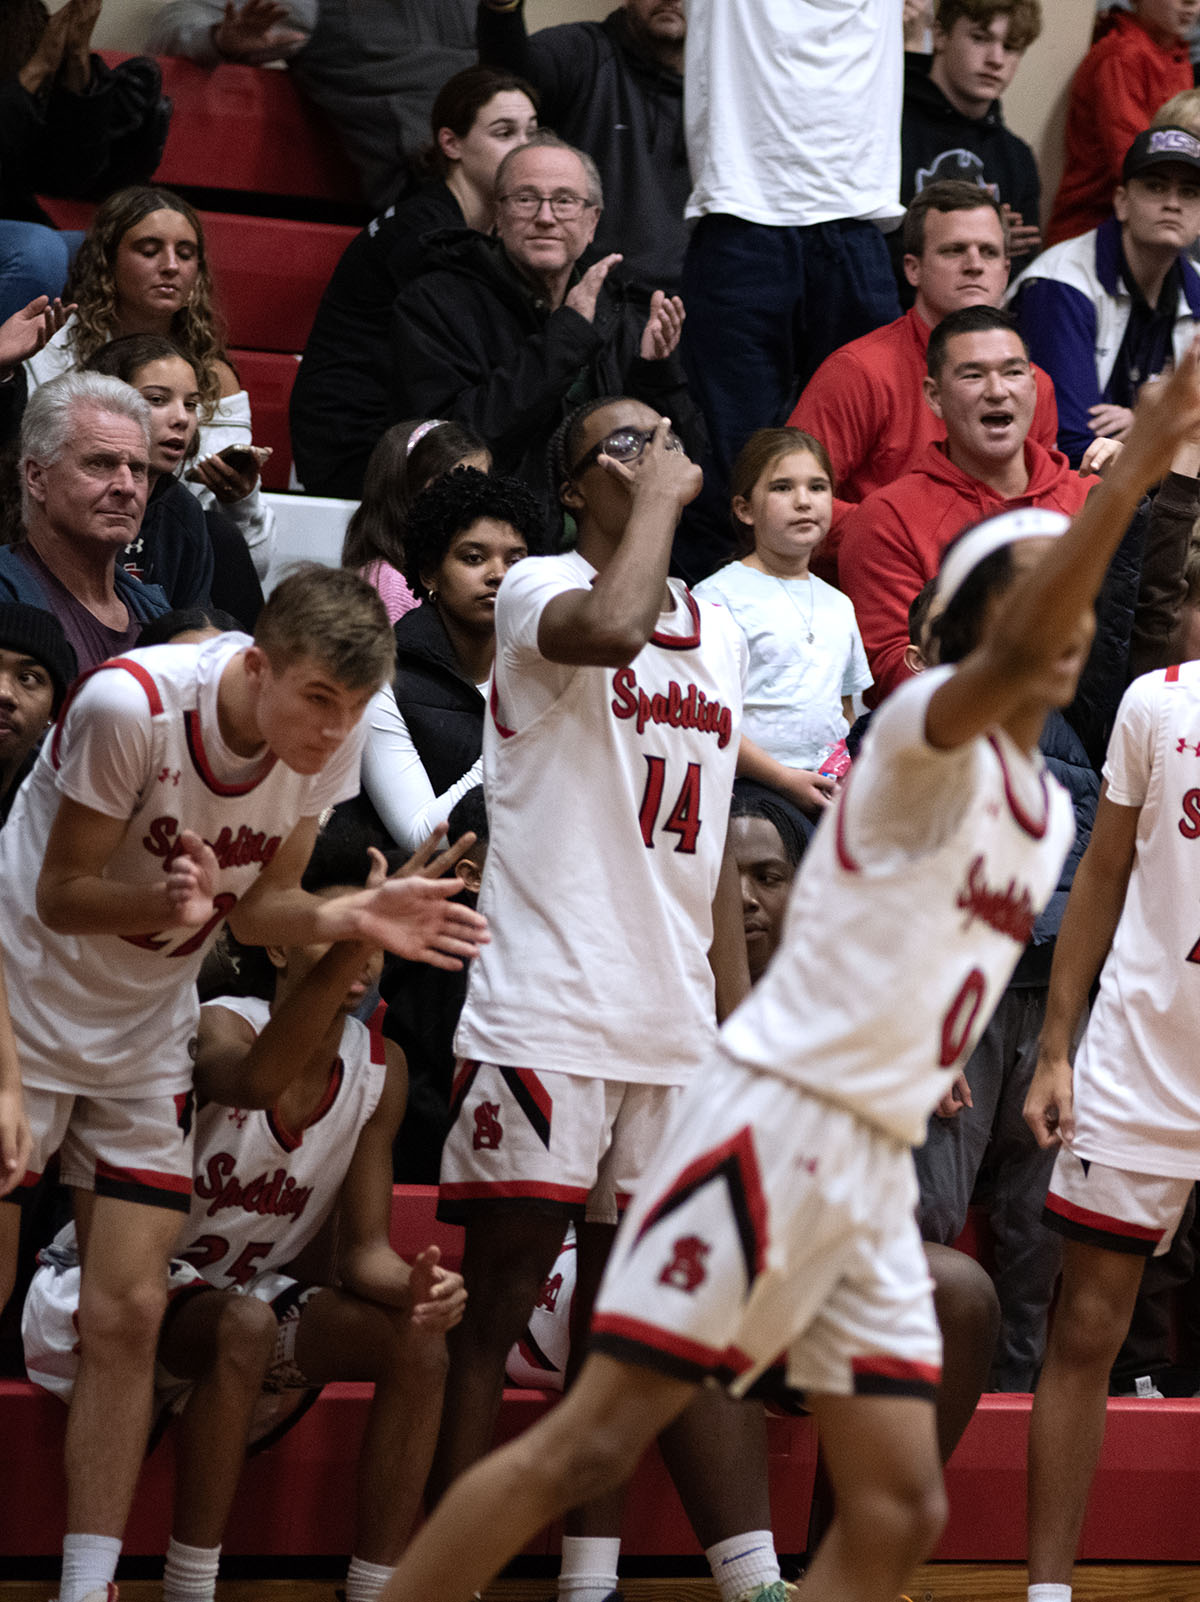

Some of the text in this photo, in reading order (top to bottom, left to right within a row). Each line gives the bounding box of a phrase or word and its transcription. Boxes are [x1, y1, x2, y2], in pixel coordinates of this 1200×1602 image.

[612, 667, 732, 750] Spalding
[637, 754, 702, 855] 14
[939, 967, 987, 1069] 0
[194, 1152, 315, 1224] Spalding
